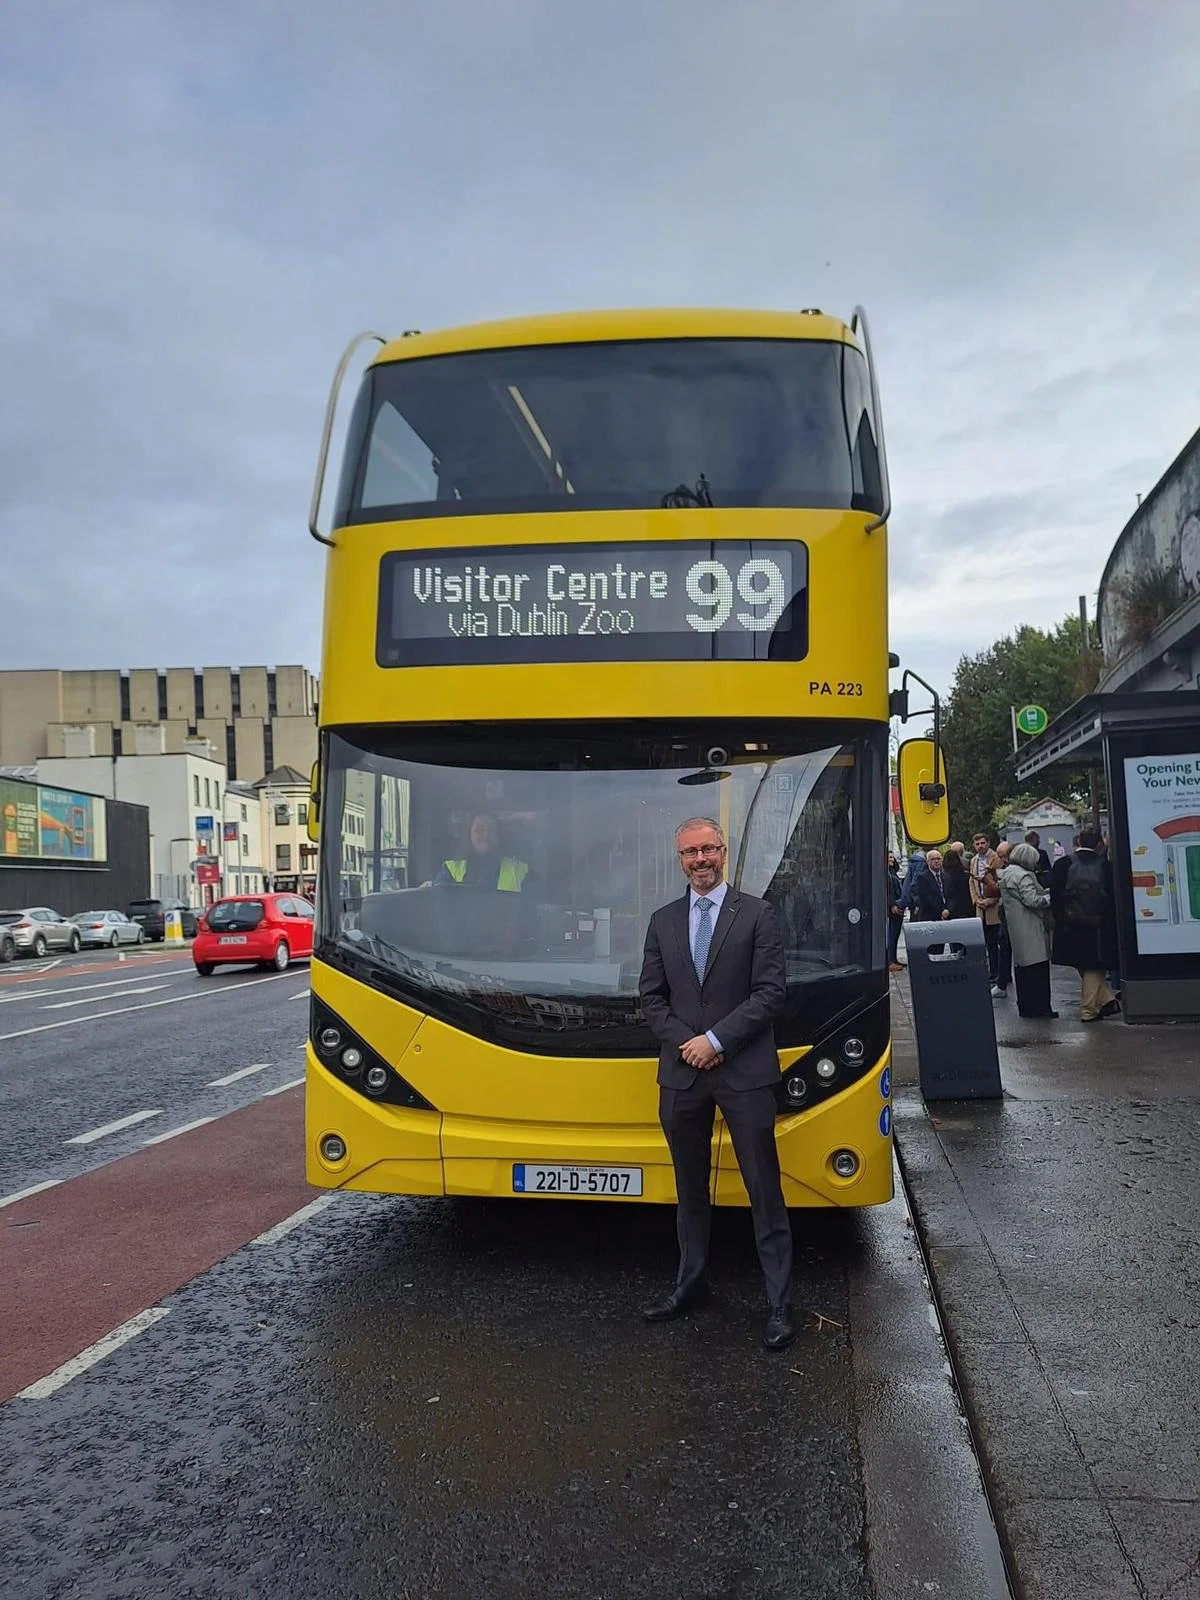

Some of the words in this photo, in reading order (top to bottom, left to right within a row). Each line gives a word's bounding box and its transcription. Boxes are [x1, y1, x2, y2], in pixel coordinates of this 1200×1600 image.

[412, 566, 530, 603] Visitor
[546, 564, 669, 600] Centre
[685, 558, 786, 633] 99
[448, 606, 489, 637] via
[497, 603, 569, 636] Dublin
[577, 602, 635, 635] Zoo
[809, 681, 832, 695] PA
[836, 682, 863, 696] 223
[1137, 762, 1192, 776] Opening
[1142, 777, 1173, 788] Your
[536, 1171, 631, 1193] 221-D-5707
